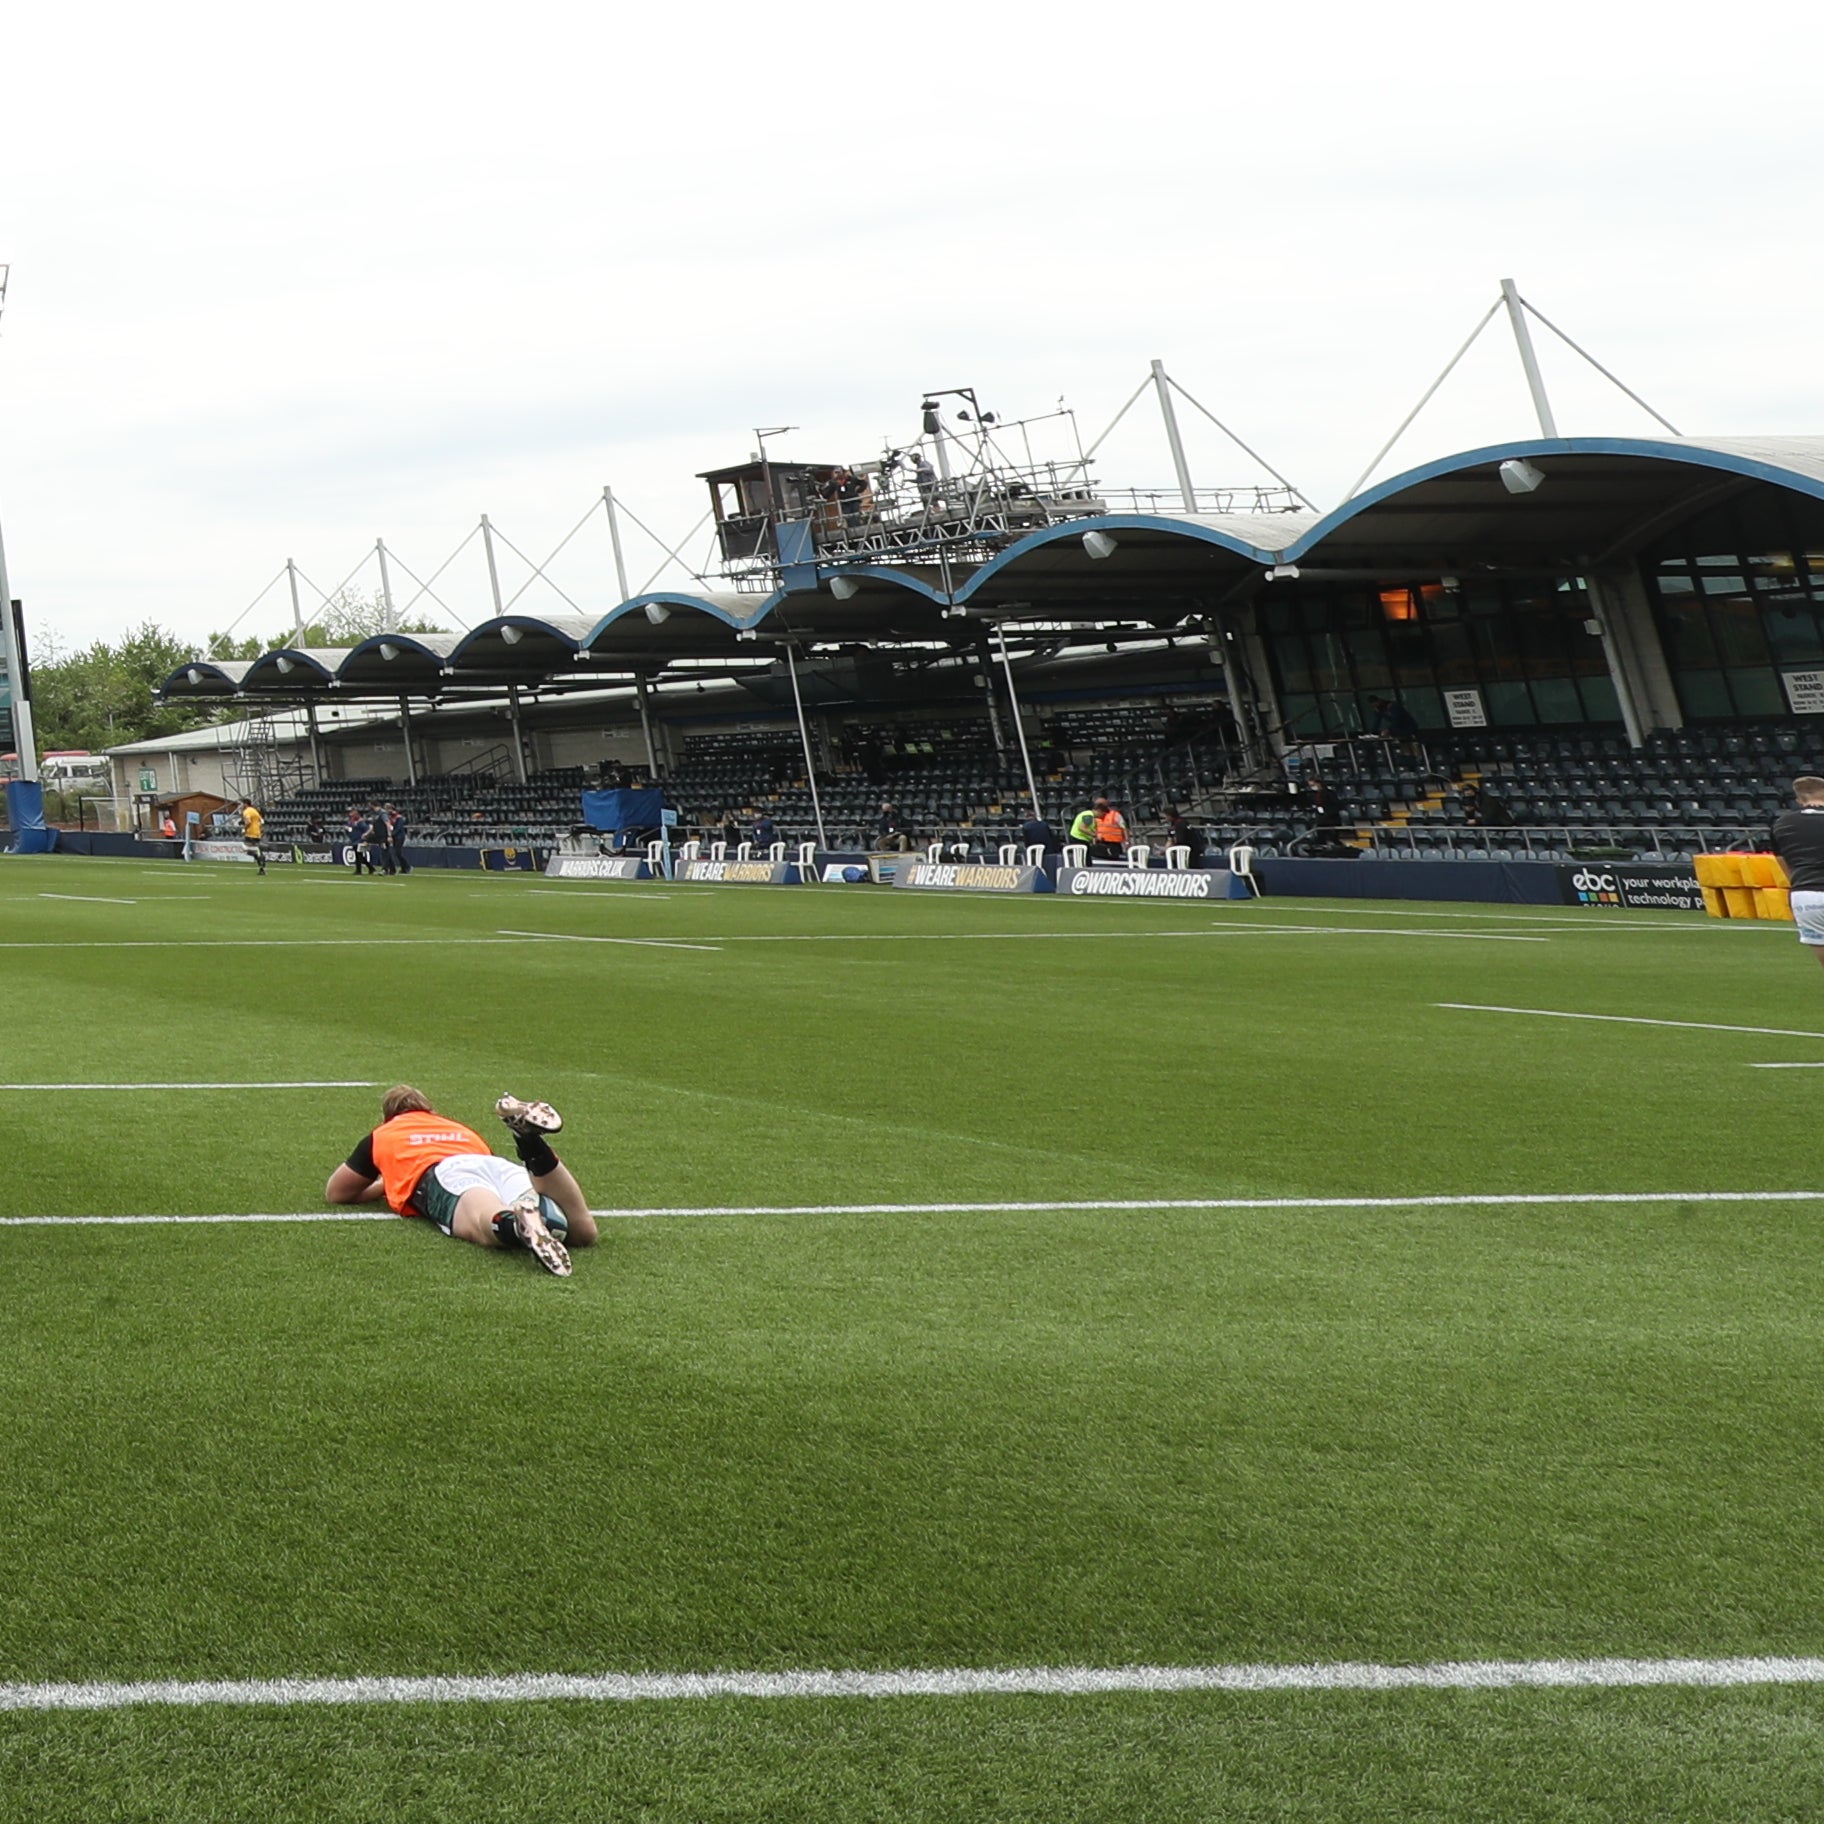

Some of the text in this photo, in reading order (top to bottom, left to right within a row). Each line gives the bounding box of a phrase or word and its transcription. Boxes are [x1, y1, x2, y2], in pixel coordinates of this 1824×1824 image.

[559, 858, 626, 877] WARRIORS.CO.UK
[687, 860, 775, 882] #WEAREWARRIORS
[906, 863, 1021, 889] #WEAREWARRIORS
[1071, 870, 1212, 897] @WORCSWARRIORS
[1572, 867, 1616, 892] ebc
[1622, 877, 1649, 891] your
[1627, 893, 1694, 909] technology
